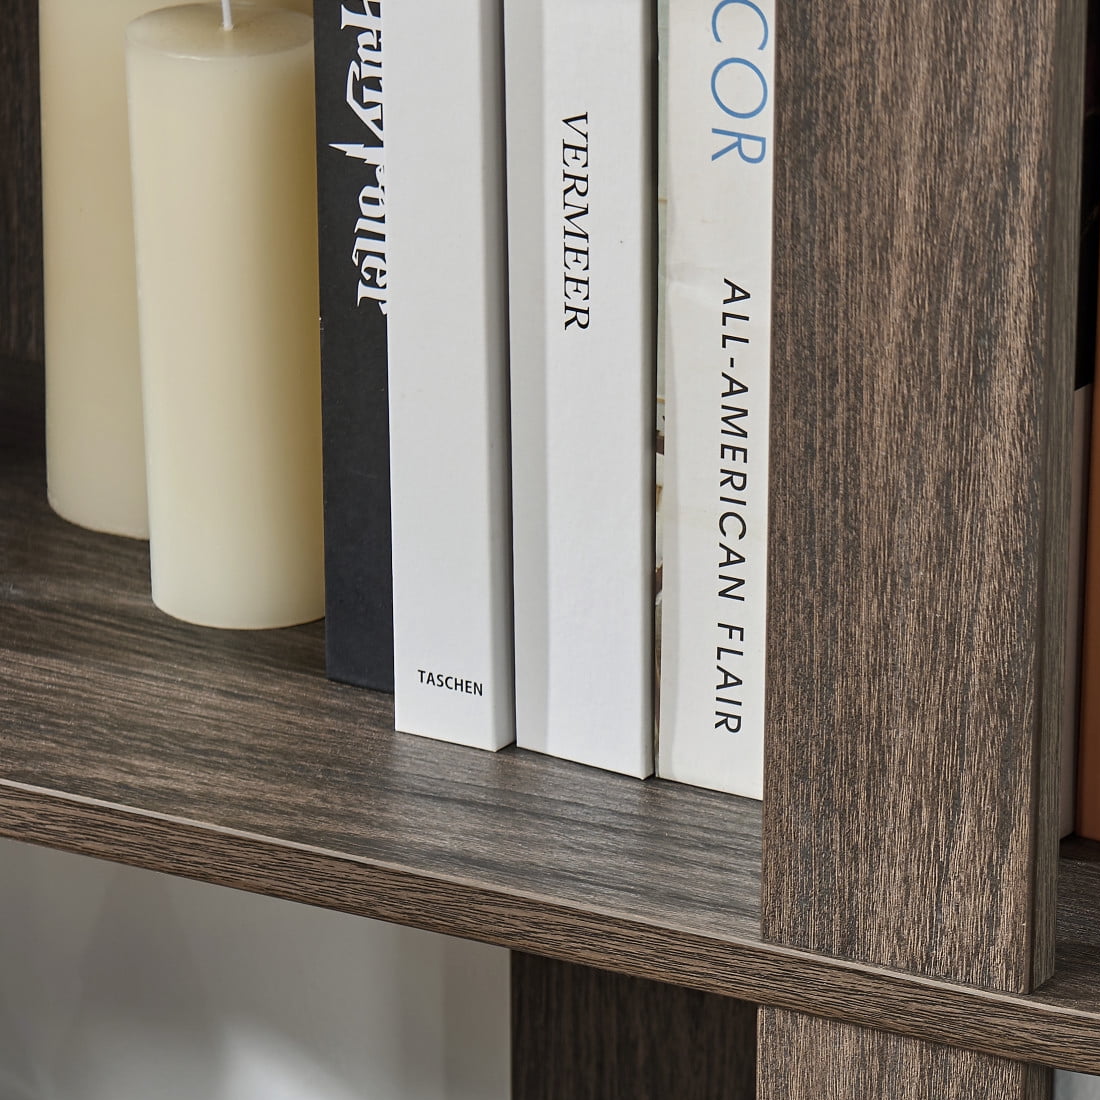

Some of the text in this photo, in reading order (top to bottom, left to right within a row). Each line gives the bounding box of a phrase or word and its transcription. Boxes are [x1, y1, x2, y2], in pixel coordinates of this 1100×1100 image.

[711, 0, 768, 166] COR
[561, 112, 590, 331] VERMEER
[714, 277, 751, 735] ALL-AMERICAN FLAIR
[417, 669, 483, 697] TASCHEN
